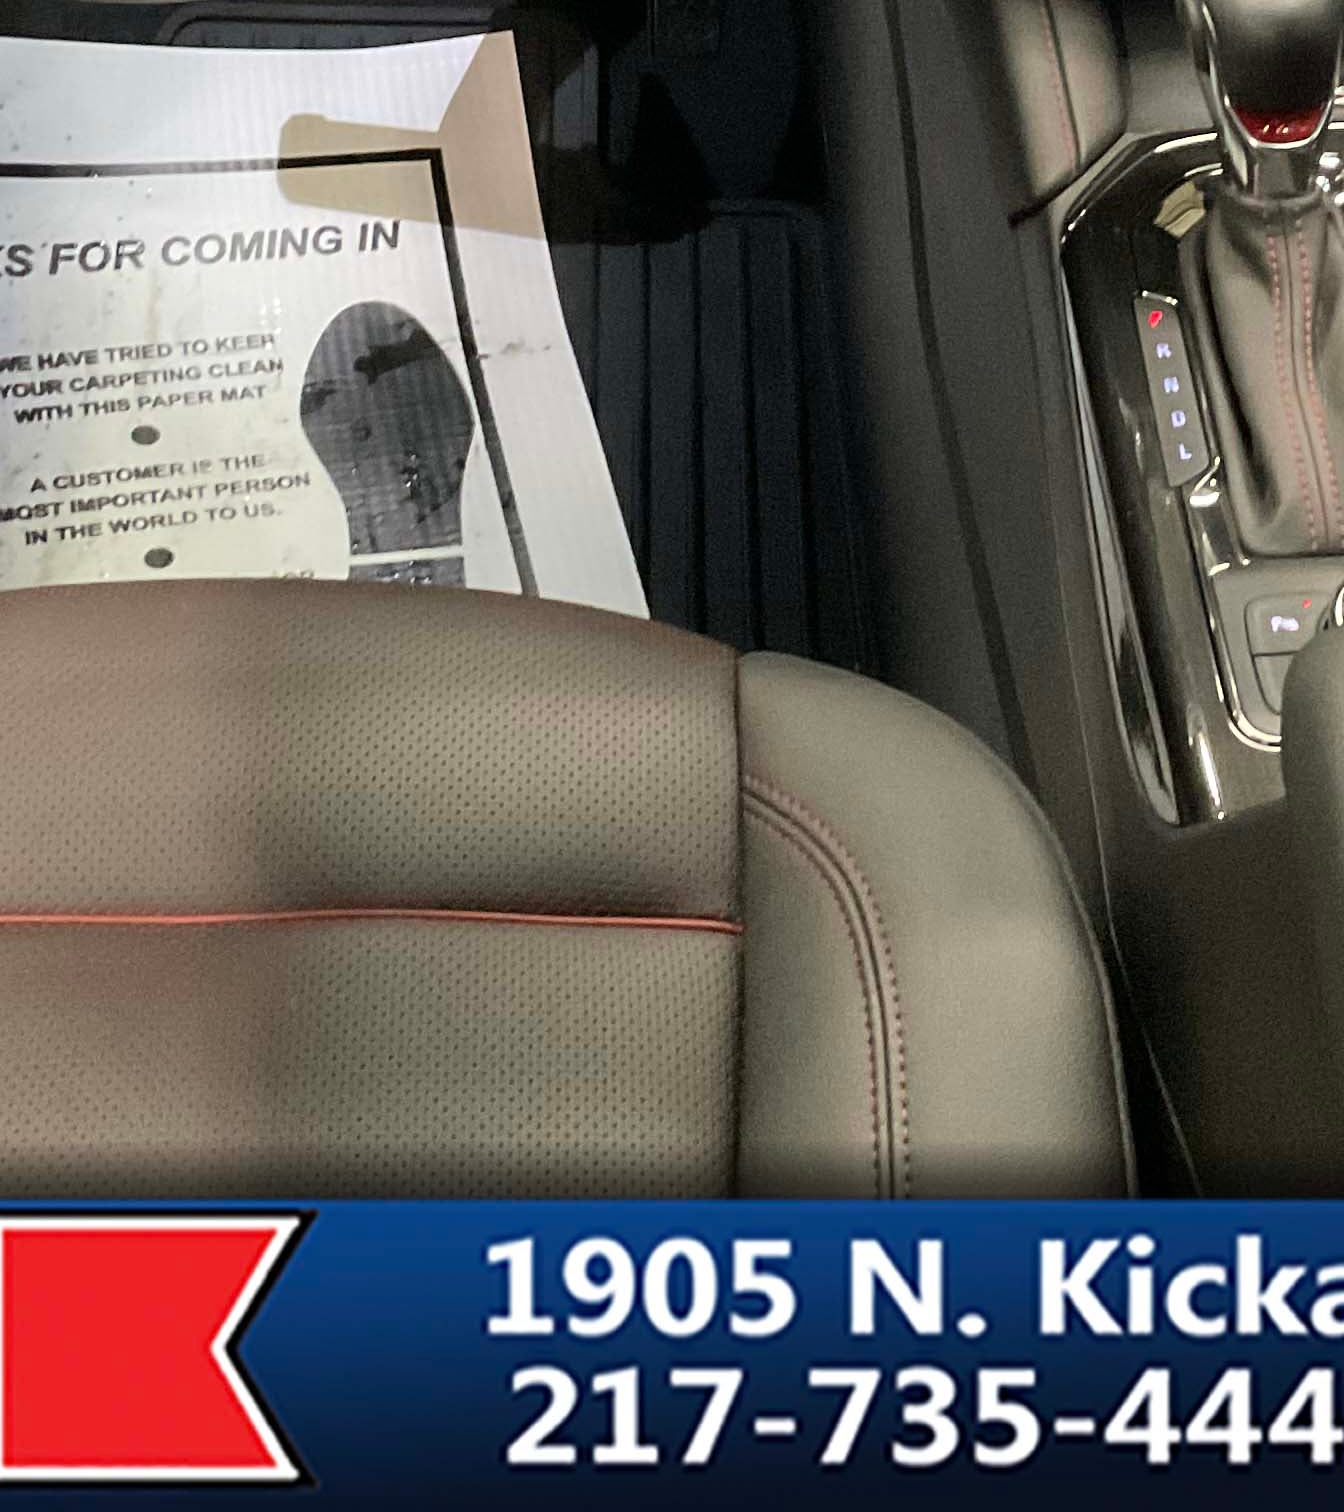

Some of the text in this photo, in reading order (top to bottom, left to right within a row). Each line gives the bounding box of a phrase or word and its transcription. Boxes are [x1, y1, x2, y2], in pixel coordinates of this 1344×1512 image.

[49, 240, 146, 276] FOR
[161, 225, 343, 266] COMING
[358, 219, 401, 252] IN
[38, 349, 99, 370] HAVE
[104, 343, 173, 364] TRIED
[181, 339, 209, 356] TO
[69, 366, 202, 393] CARPETING
[208, 357, 284, 378] CLEAN
[14, 385, 268, 425] WITH THIS PAPER MAT
[1171, 410, 1186, 428] D
[1179, 443, 1192, 460] L
[30, 453, 266, 493] A CUSTOMER IS THE
[70, 487, 208, 514] IMPORTANT
[214, 472, 311, 498] PERSON
[24, 501, 283, 545] IN THE WORLD TO US.
